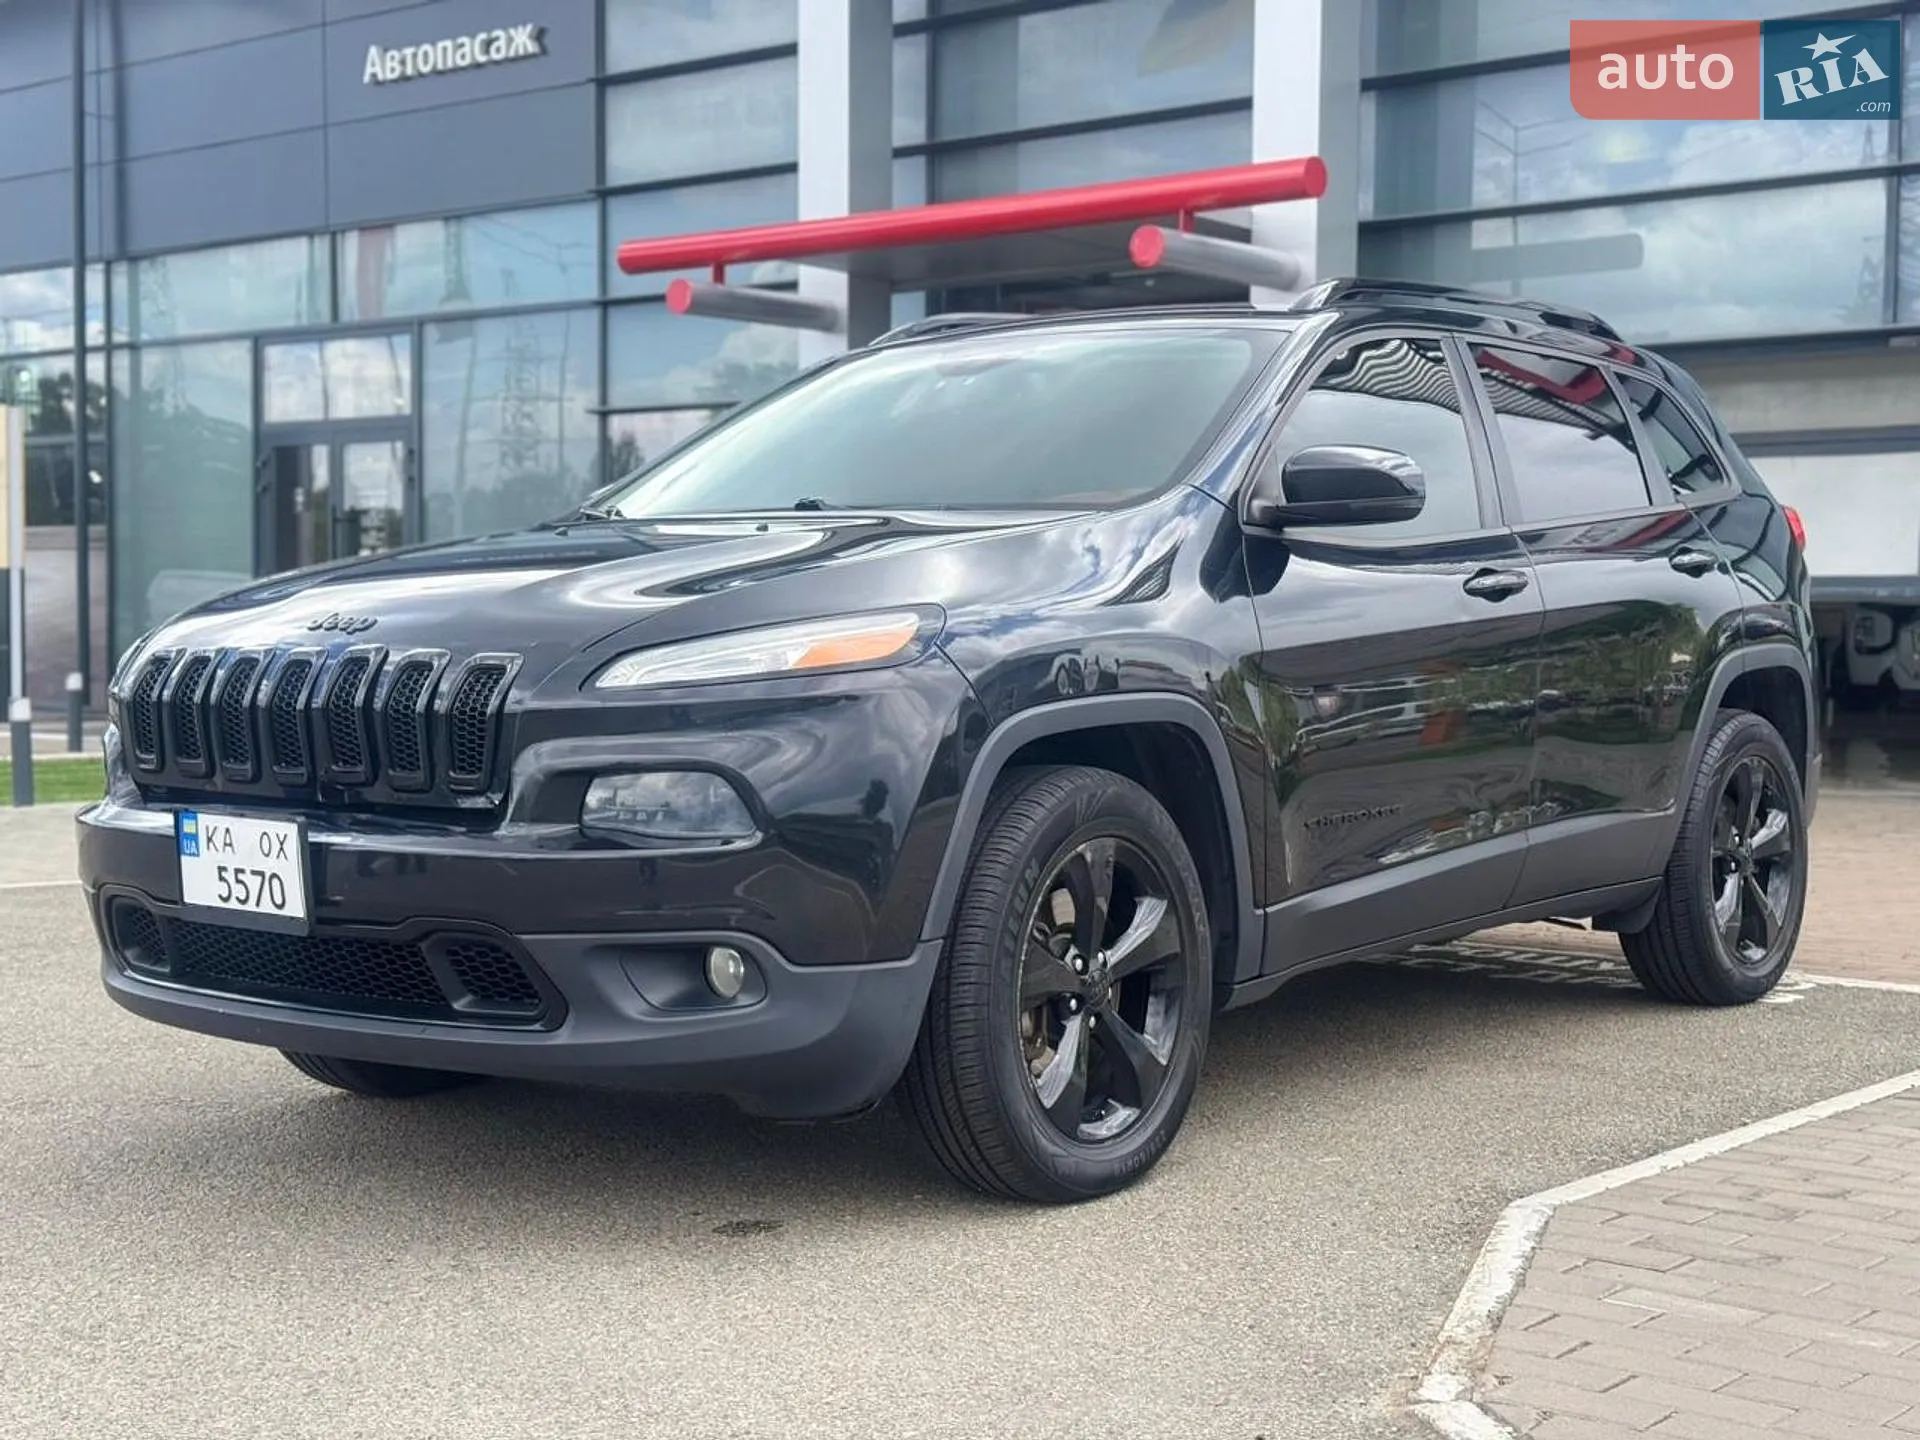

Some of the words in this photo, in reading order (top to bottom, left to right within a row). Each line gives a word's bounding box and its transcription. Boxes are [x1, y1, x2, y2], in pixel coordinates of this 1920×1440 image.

[363, 23, 541, 84] Автопасаж
[306, 612, 379, 636] Jeep
[183, 838, 199, 855] UA
[205, 824, 236, 855] KA
[216, 865, 287, 911] 5570
